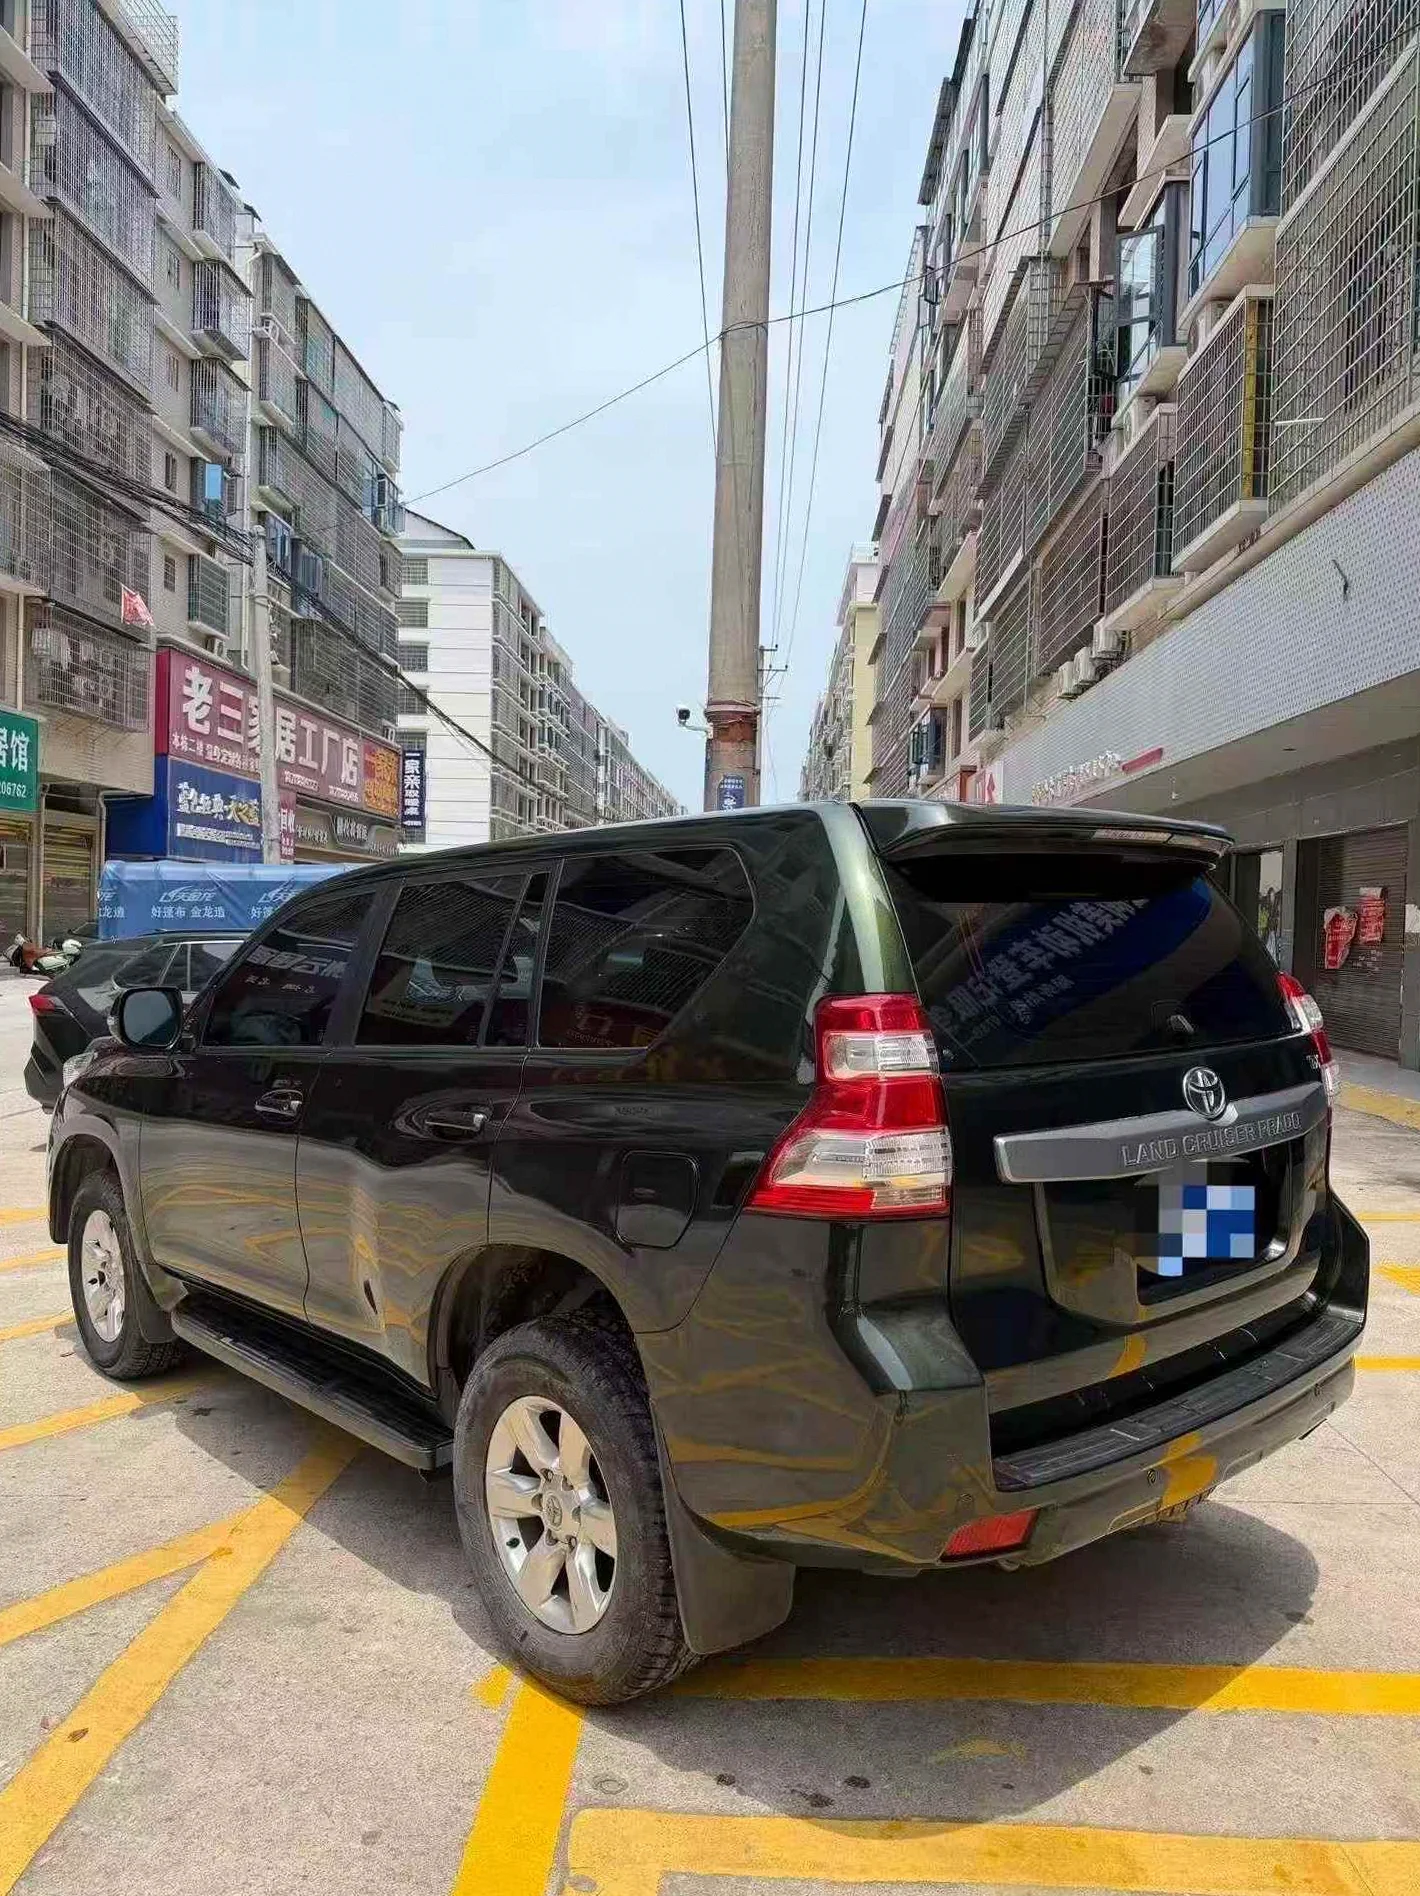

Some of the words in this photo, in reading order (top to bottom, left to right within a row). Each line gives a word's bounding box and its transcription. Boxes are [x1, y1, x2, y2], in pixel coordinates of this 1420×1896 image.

[1121, 1137, 1179, 1167] LAND
[1182, 1122, 1255, 1157] CRUISER
[1258, 1111, 1301, 1139] PRADO
